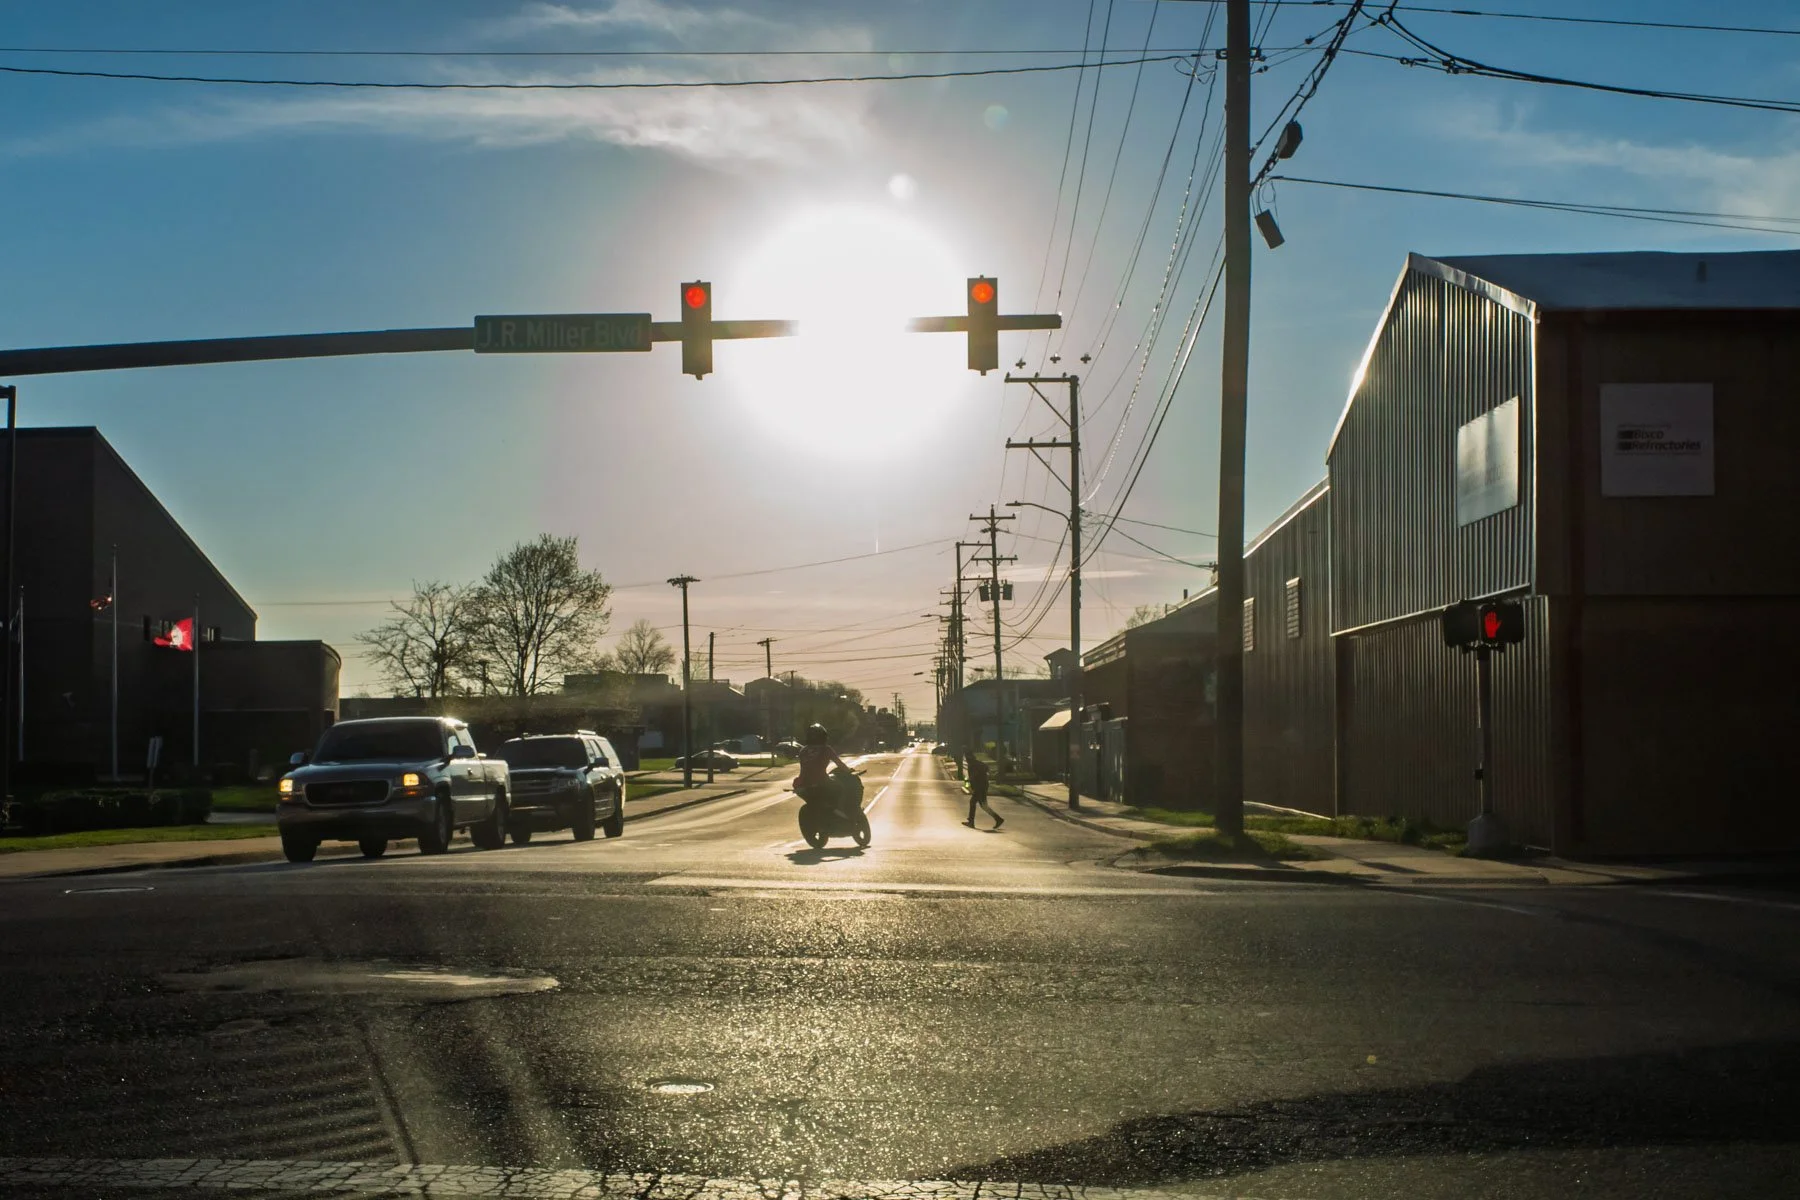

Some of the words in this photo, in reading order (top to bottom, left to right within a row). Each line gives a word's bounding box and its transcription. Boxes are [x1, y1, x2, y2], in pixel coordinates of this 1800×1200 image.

[526, 320, 590, 347] Miller
[595, 319, 642, 346] Blvd
[1631, 439, 1701, 450] Refractories
